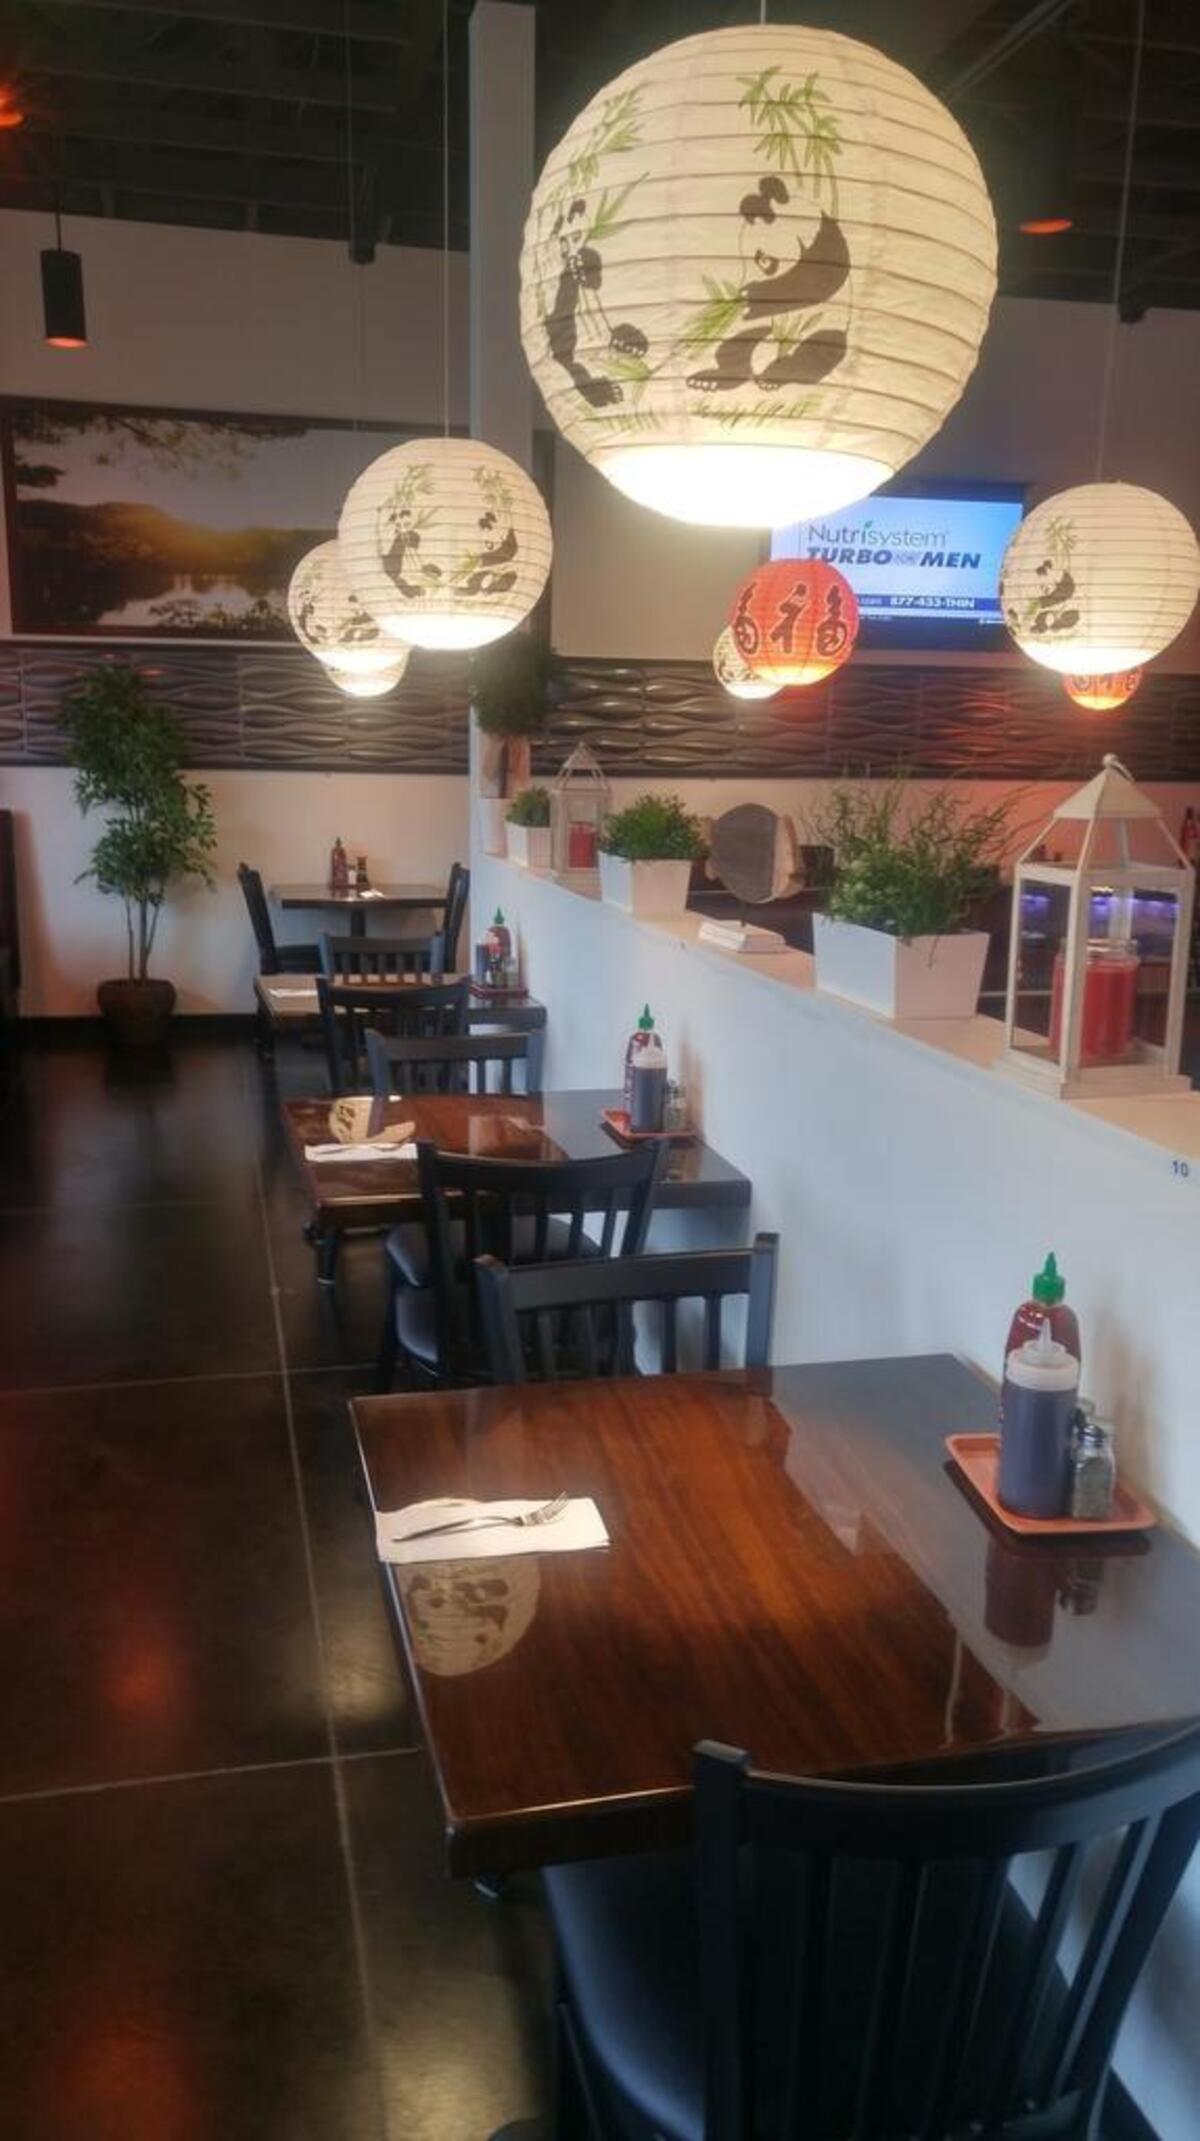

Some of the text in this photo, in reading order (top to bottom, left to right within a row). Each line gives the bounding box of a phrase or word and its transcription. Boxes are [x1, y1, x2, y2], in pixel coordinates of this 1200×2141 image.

[808, 521, 947, 547] Nutrisystem
[807, 547, 893, 565] TURBO
[919, 551, 982, 569] MEN
[1172, 1160, 1189, 1178] 10
